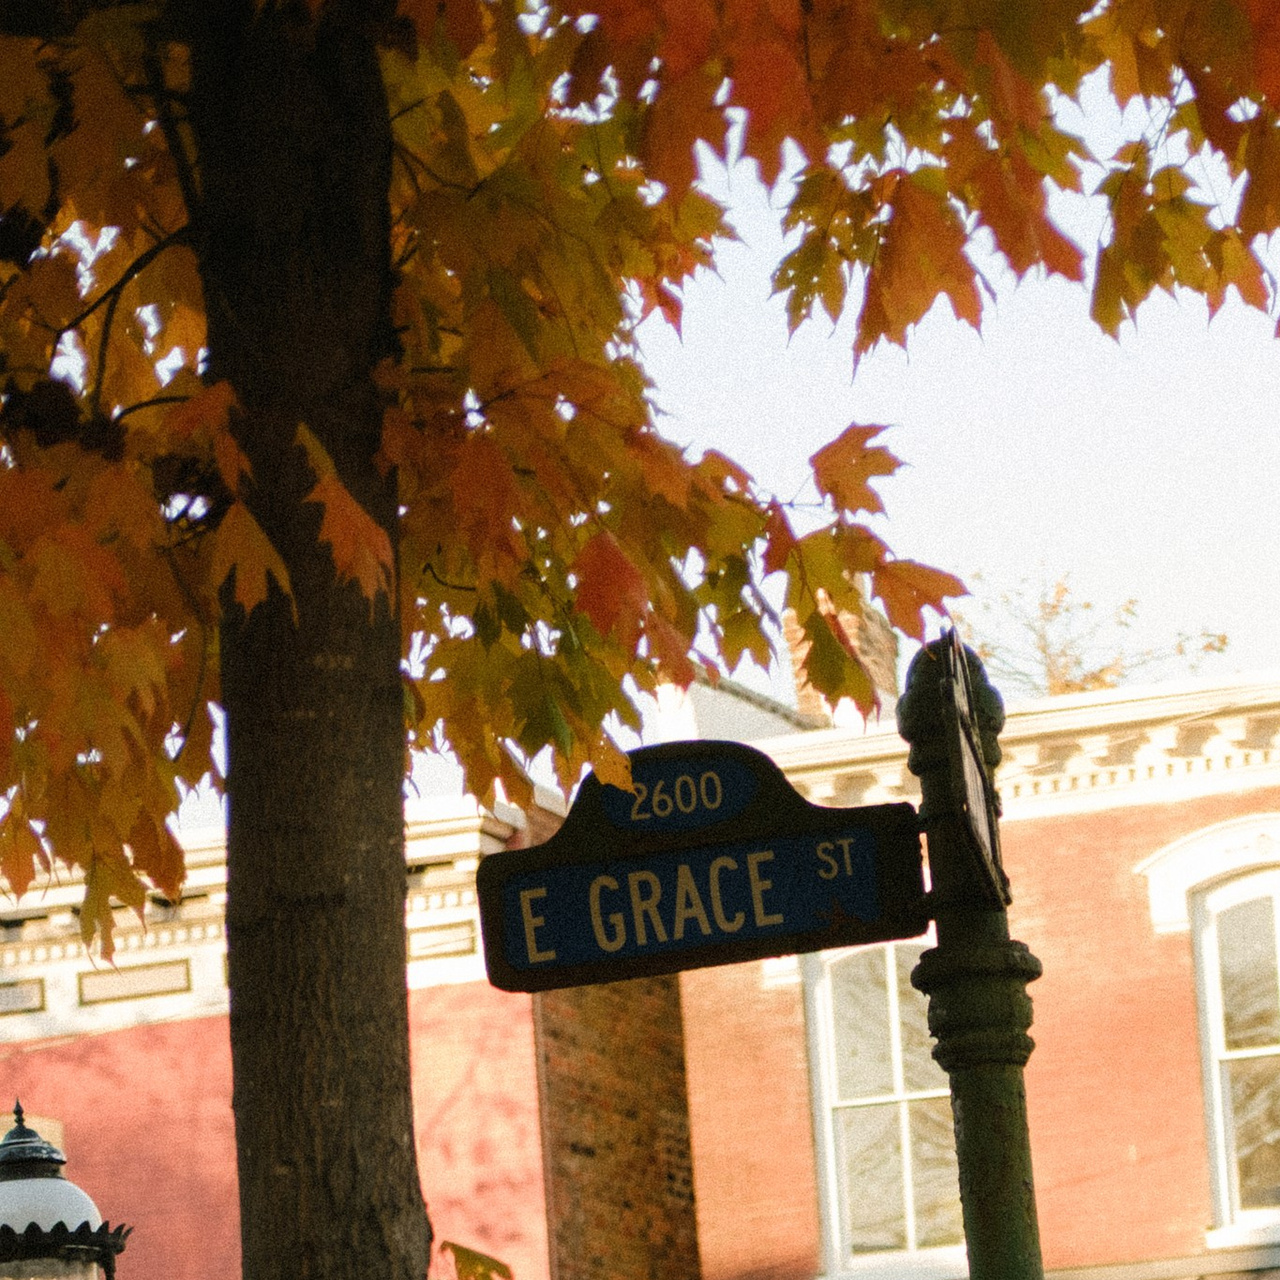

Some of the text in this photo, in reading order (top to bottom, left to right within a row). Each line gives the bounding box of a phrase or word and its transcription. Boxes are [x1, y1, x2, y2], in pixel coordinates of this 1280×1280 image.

[631, 771, 723, 821] 2600
[519, 838, 855, 964] E GRACE ST
